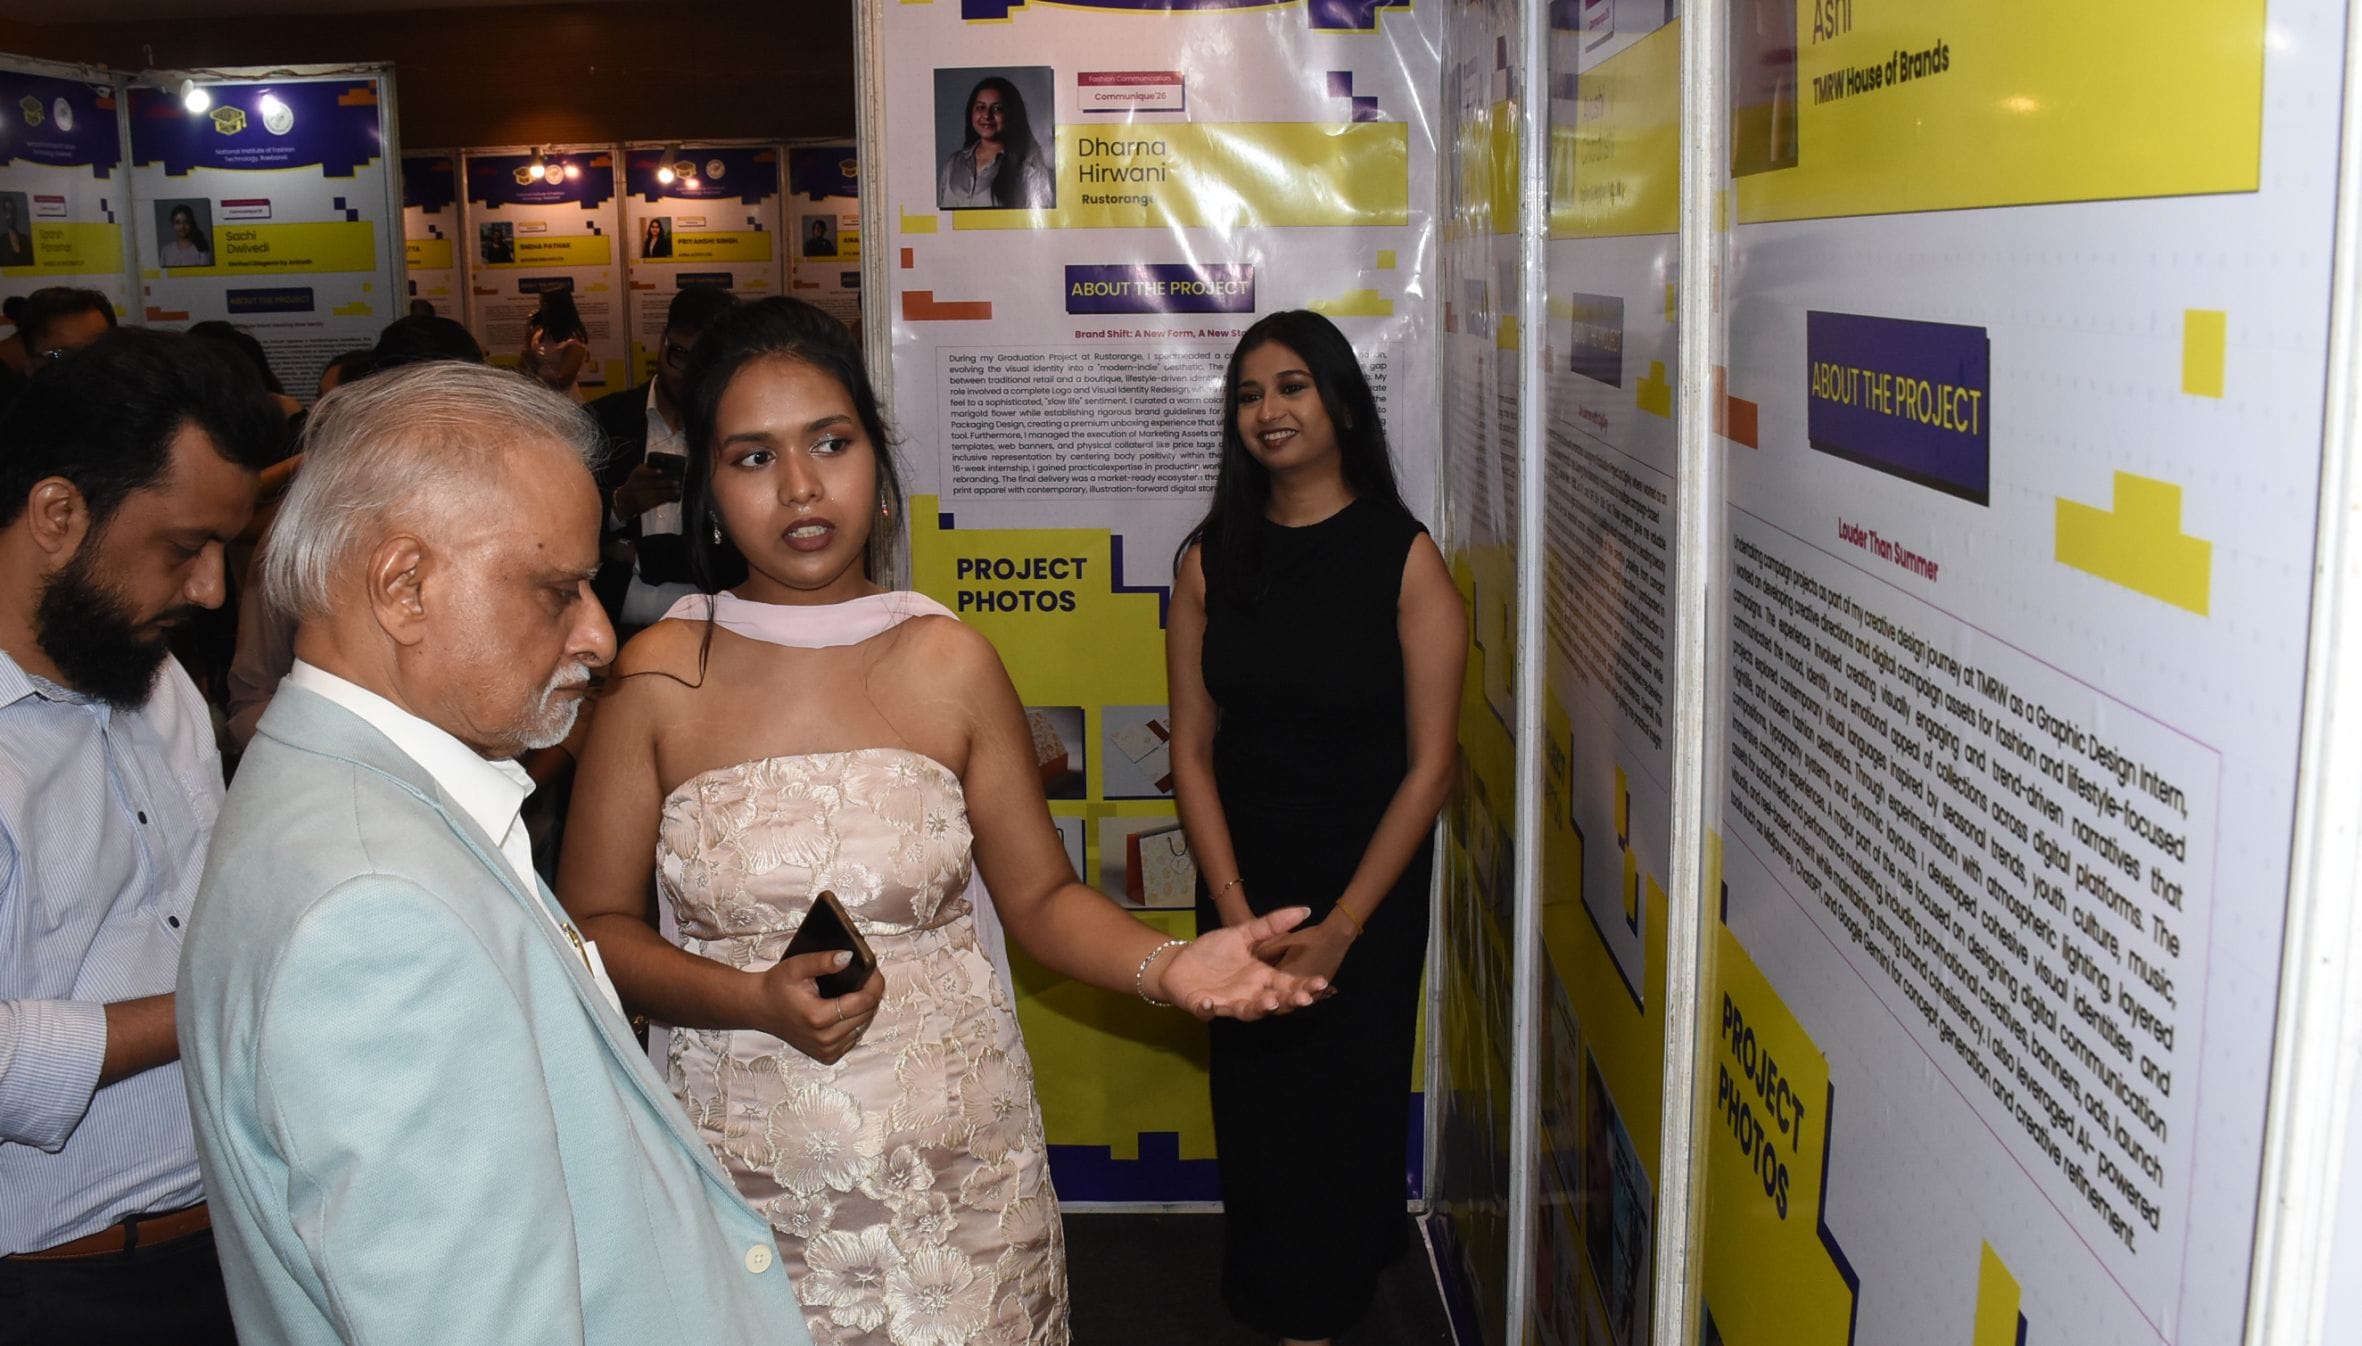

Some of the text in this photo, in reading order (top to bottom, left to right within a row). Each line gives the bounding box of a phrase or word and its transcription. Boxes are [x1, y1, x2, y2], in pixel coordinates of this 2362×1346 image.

[1812, 38, 1949, 106] TMRW House of Brands
[1095, 92, 1167, 101] Communique'26
[1079, 138, 1166, 157] Dharna
[1079, 163, 1166, 183] Hirwani
[226, 231, 256, 241] Sachi
[227, 243, 270, 254] Dwivedi
[1071, 280, 1249, 296] ABOUT THE PROJECT
[1075, 330, 1105, 339] Brand
[1107, 329, 1133, 338] Shift:
[1134, 330, 1142, 338] A
[1144, 330, 1165, 338] New
[1167, 329, 1196, 339] Form,
[1207, 329, 1229, 337] New
[1231, 329, 1248, 337] Sto
[949, 353, 977, 364] During
[980, 353, 995, 364] my
[1048, 353, 1078, 363] Project
[1081, 353, 1091, 361] at
[949, 365, 985, 375] evolving
[987, 365, 1002, 373] the
[1004, 364, 1030, 373] visual
[1033, 364, 1064, 374] identity
[1067, 363, 1084, 372] into
[949, 376, 986, 385] between
[1032, 375, 1055, 384] retail
[1056, 375, 1074, 383] and
[966, 387, 1002, 396] involved
[1010, 386, 1051, 396] complete
[1051, 386, 1072, 396] Logo
[1091, 385, 1117, 394] Visual
[1118, 385, 1150, 395] Identity
[1812, 361, 1982, 435] ABOUT THE PROJECT
[950, 409, 989, 419] marigold
[991, 409, 1017, 417] flower
[1019, 408, 1042, 417] while
[1097, 407, 1132, 417] rigorous
[1134, 407, 1161, 416] brand
[1028, 430, 1070, 440] managed
[1071, 430, 1085, 439] the
[1181, 430, 1210, 438] Assets
[996, 440, 1112, 451] physical
[997, 442, 1016, 450] web
[1018, 441, 1055, 451] banners,
[1057, 441, 1075, 450] and
[1172, 440, 1194, 450] price
[1196, 440, 1215, 450] tags
[1055, 452, 1067, 462] by
[1113, 451, 1136, 462] body
[1179, 451, 1205, 459] within
[1036, 463, 1067, 473] gained
[1001, 475, 1017, 484] The
[1018, 474, 1036, 483] final
[1037, 474, 1070, 484] delivery
[953, 485, 972, 496] print
[973, 485, 1006, 496] apparel
[1007, 485, 1026, 494] with
[1170, 484, 1197, 494] digital
[1838, 517, 1939, 582] Louder Than Summer
[957, 558, 1087, 580] PROJECT
[958, 590, 1076, 612] PHOTOS
[1976, 668, 2188, 819] TMRW as Graphic Design Intern,
[1979, 709, 2185, 863] for fashion and lifestyle-focused
[1965, 744, 2183, 912] and trend-driven narratives that
[1992, 801, 2180, 958] across digital platforms. The
[1991, 836, 2176, 1009] trends, youth culture, music,
[1987, 876, 2174, 1052] atmospheric lighting, layered
[1981, 910, 2171, 1097] cohesive visual identities and
[1968, 934, 2166, 1142] designing digital communication
[1722, 991, 1805, 1154] PROJECT
[1979, 986, 2163, 1187] creatives, banners, ads, launch
[1718, 1062, 1789, 1220] PHOTOS
[1992, 1038, 2160, 1232] also leveraged AI- powered
[1992, 1077, 2136, 1254] and creative refinement.
